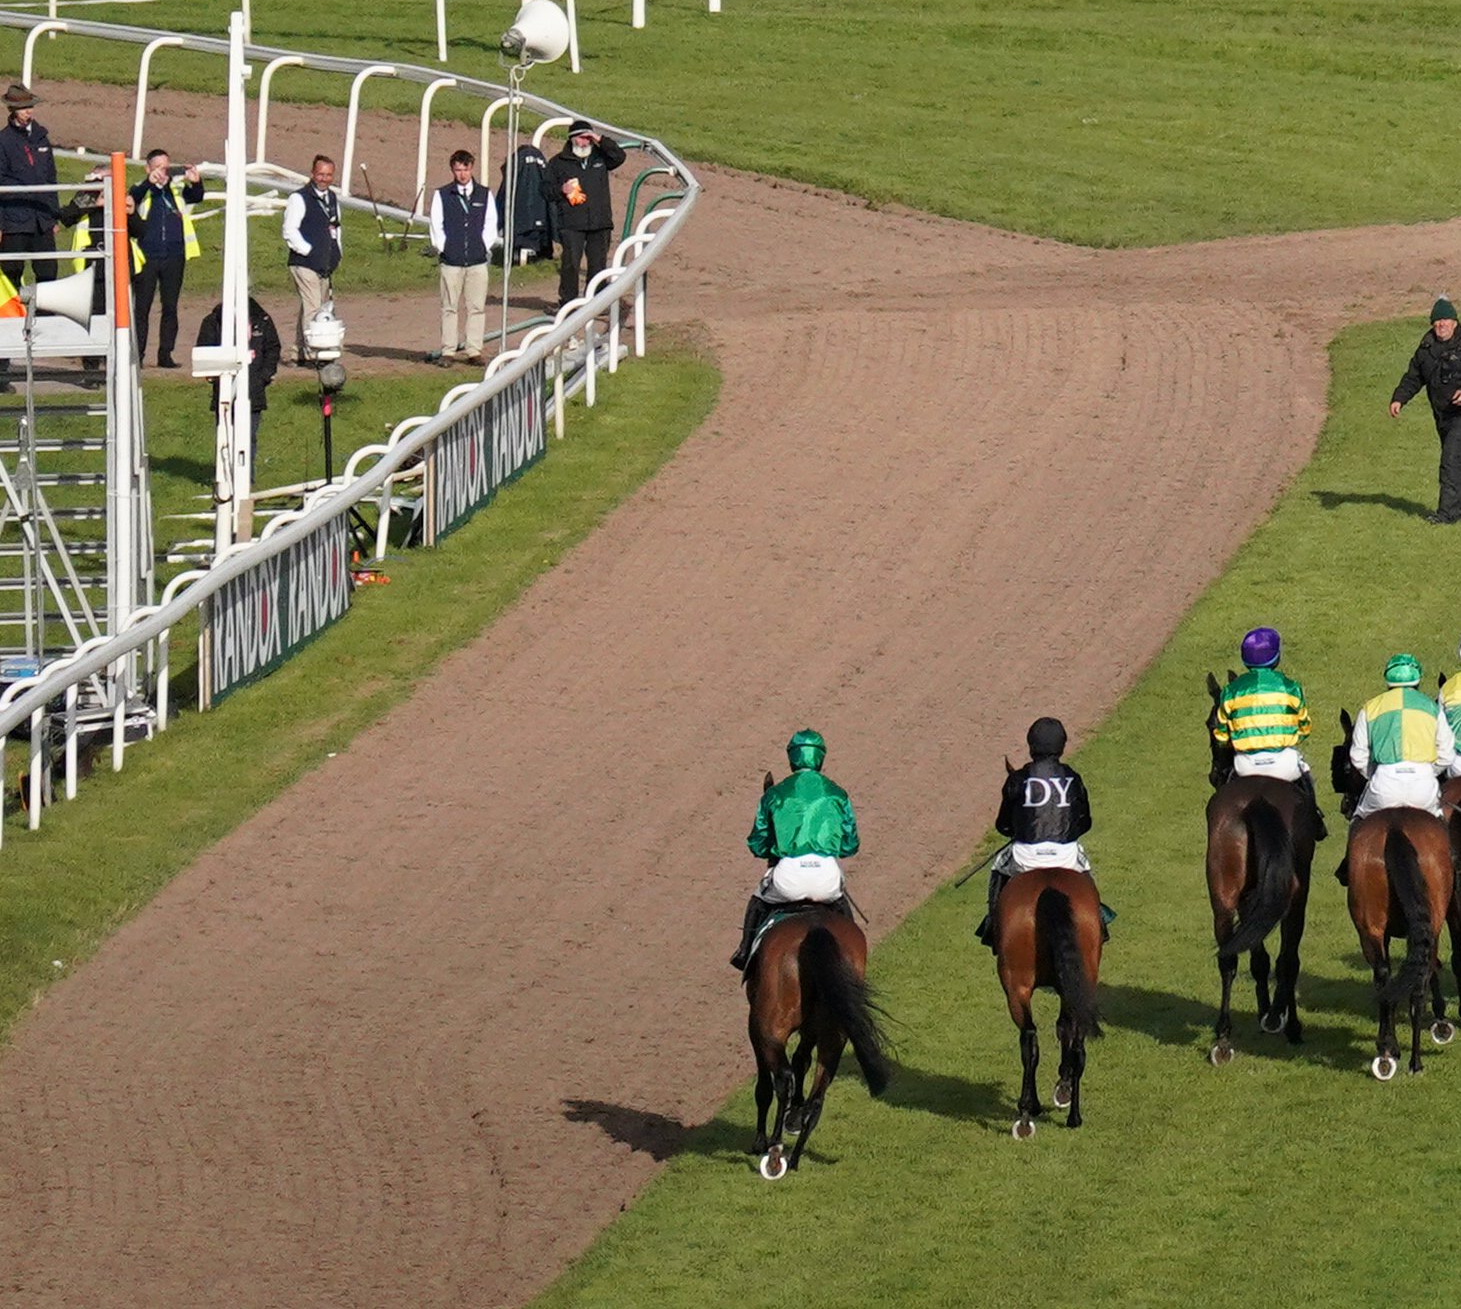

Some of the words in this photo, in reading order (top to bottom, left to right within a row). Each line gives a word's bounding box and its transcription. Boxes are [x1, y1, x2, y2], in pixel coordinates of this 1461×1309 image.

[437, 403, 488, 535] RANDOX
[492, 358, 543, 488] RANDOX
[214, 552, 281, 694] RANDOX
[288, 511, 349, 648] RANDOX
[1022, 777, 1074, 808] DY
